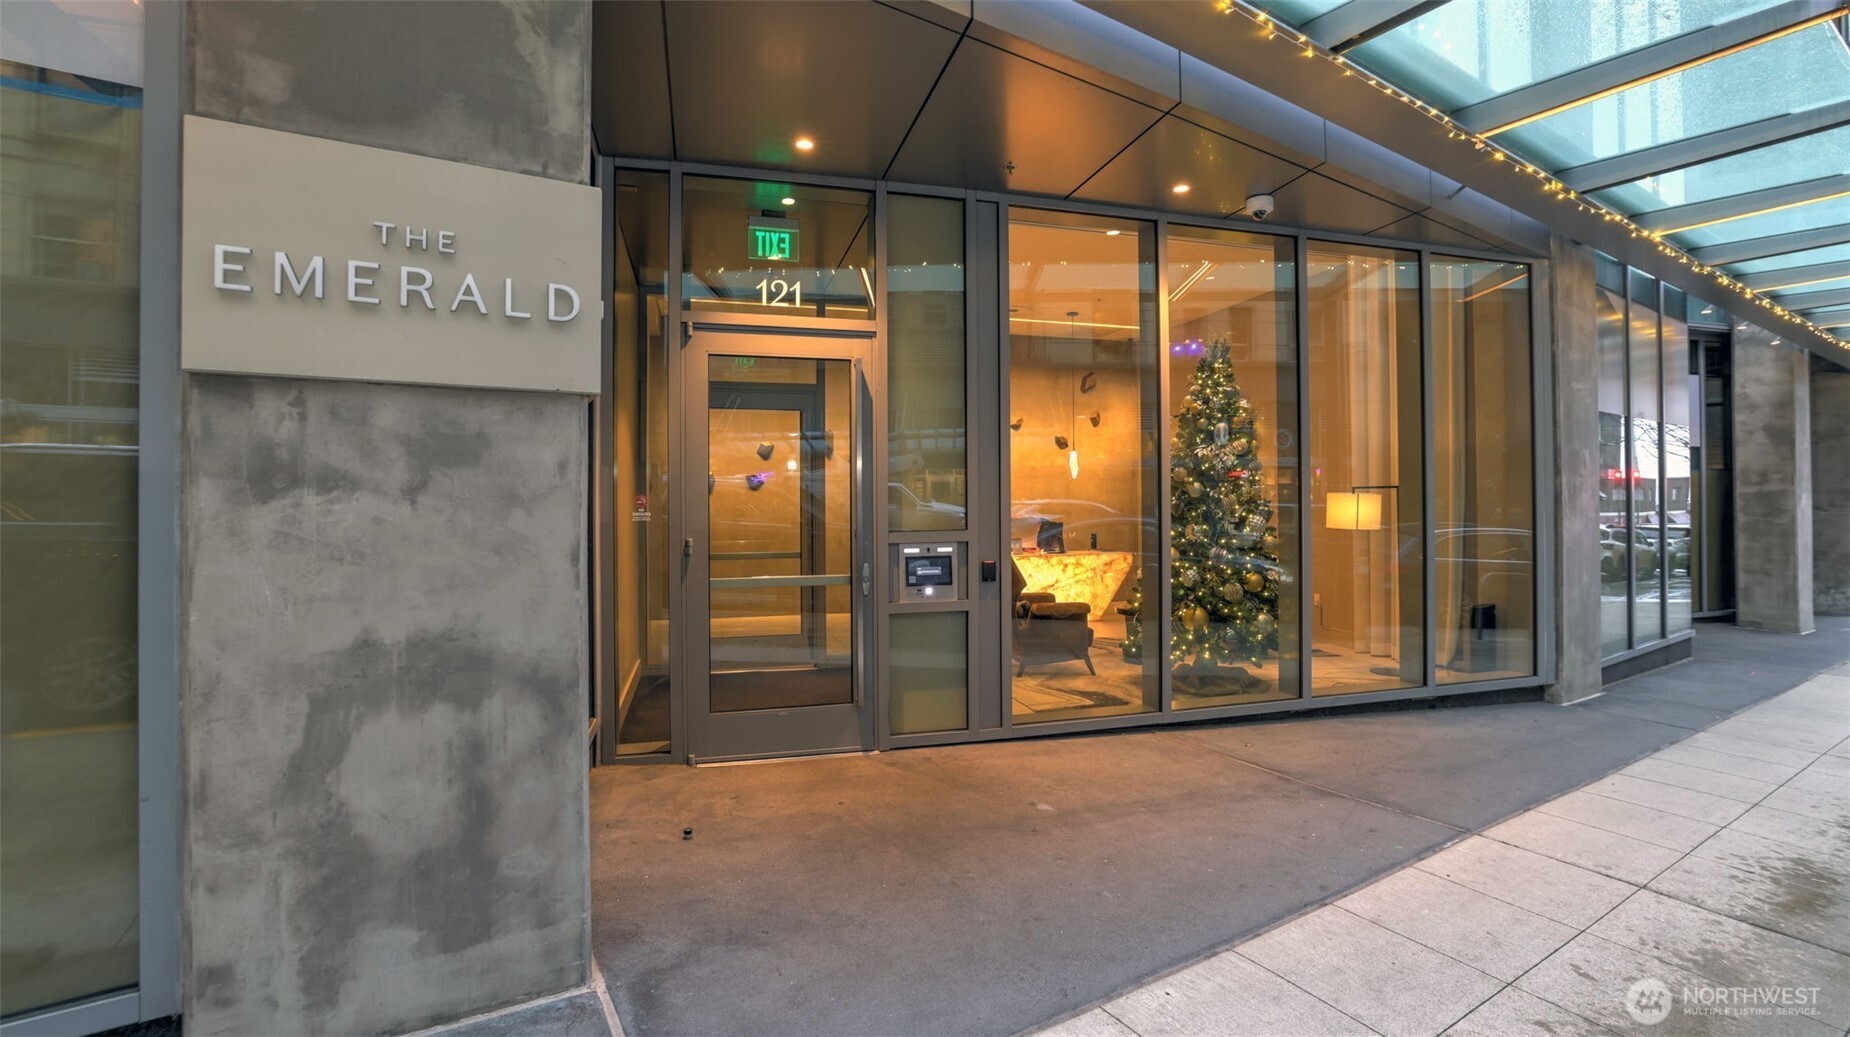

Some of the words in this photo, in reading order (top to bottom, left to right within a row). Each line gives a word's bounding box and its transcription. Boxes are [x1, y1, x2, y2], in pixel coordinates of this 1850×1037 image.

[373, 221, 456, 254] THE
[213, 244, 581, 323] EMERALD
[755, 278, 802, 308] 121
